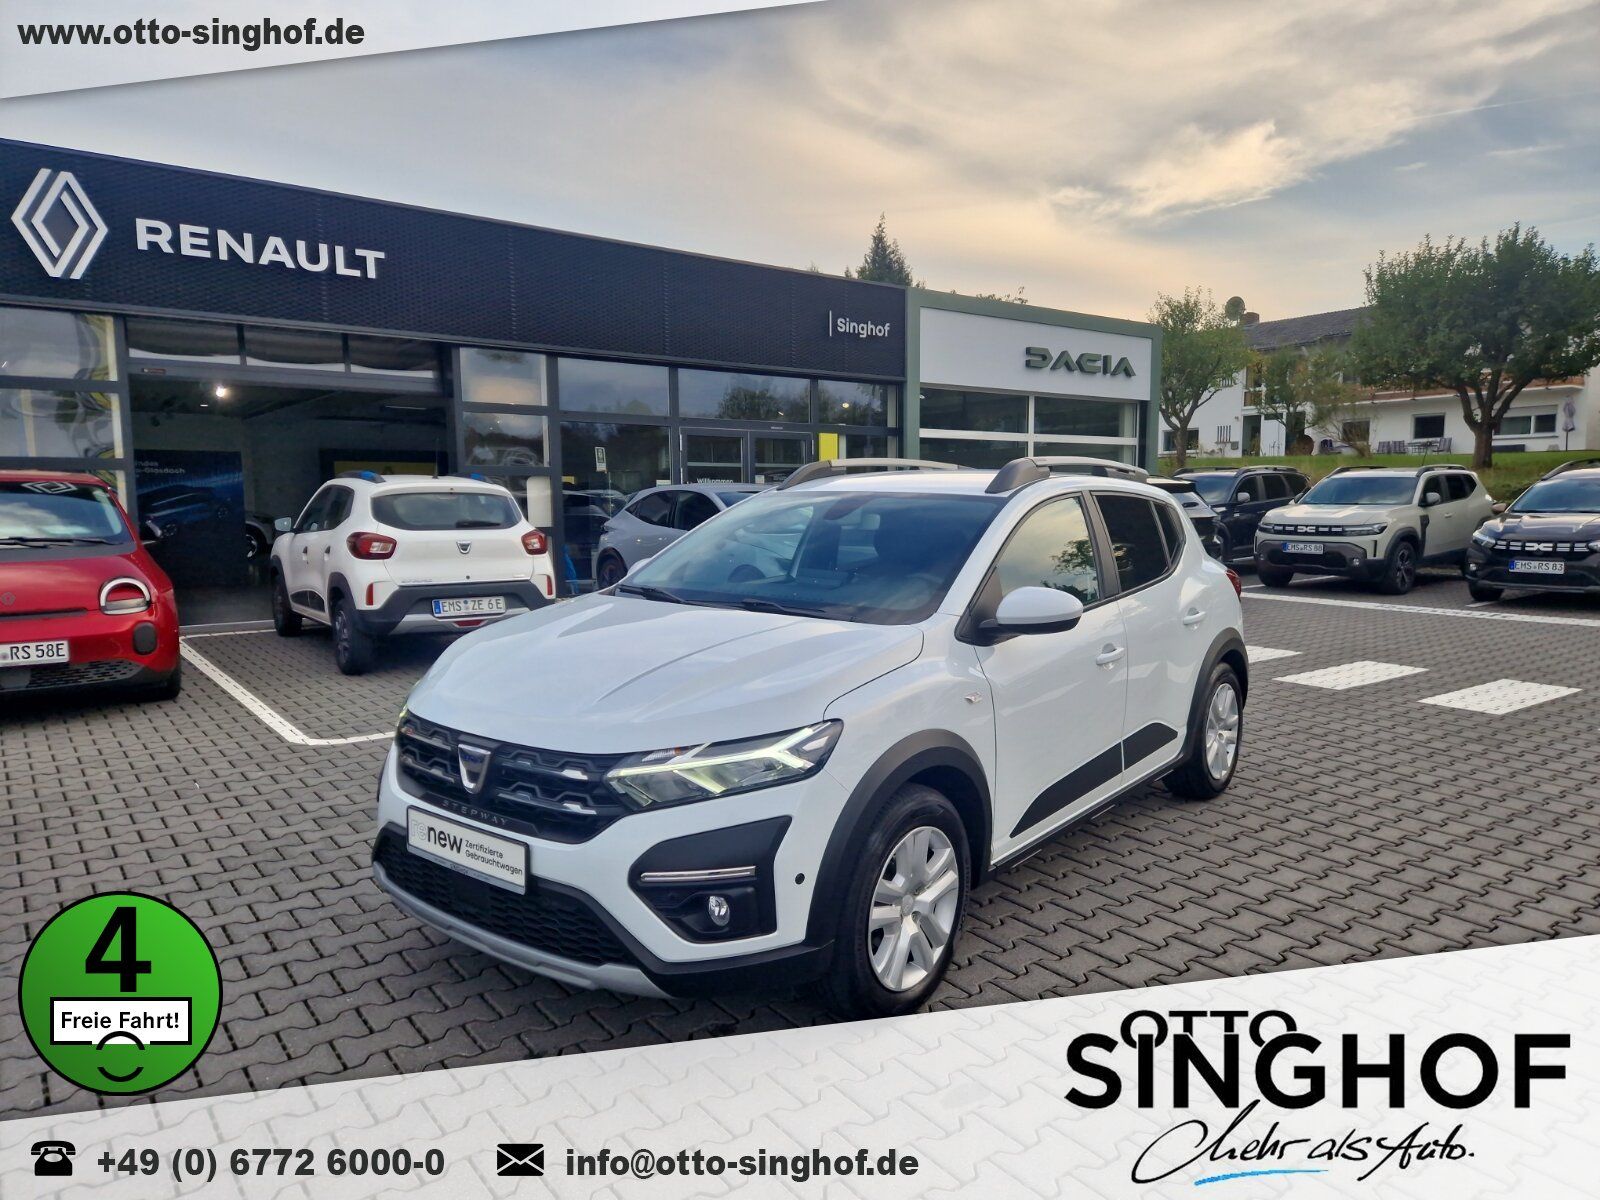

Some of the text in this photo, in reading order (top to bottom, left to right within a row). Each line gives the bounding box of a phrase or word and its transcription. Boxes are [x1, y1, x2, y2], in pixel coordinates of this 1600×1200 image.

[135, 217, 386, 279] RENAULT
[836, 317, 891, 338] Singhof
[1025, 346, 1136, 378] DACIA
[1514, 561, 1564, 572] EMS RS 83
[441, 600, 462, 613] EMS
[471, 599, 484, 611] ZE
[10, 643, 66, 660] RS 58E
[442, 799, 507, 826] STEPWAY
[465, 839, 504, 860] Zertifizierte
[465, 849, 523, 877] Gebrauchtwagen
